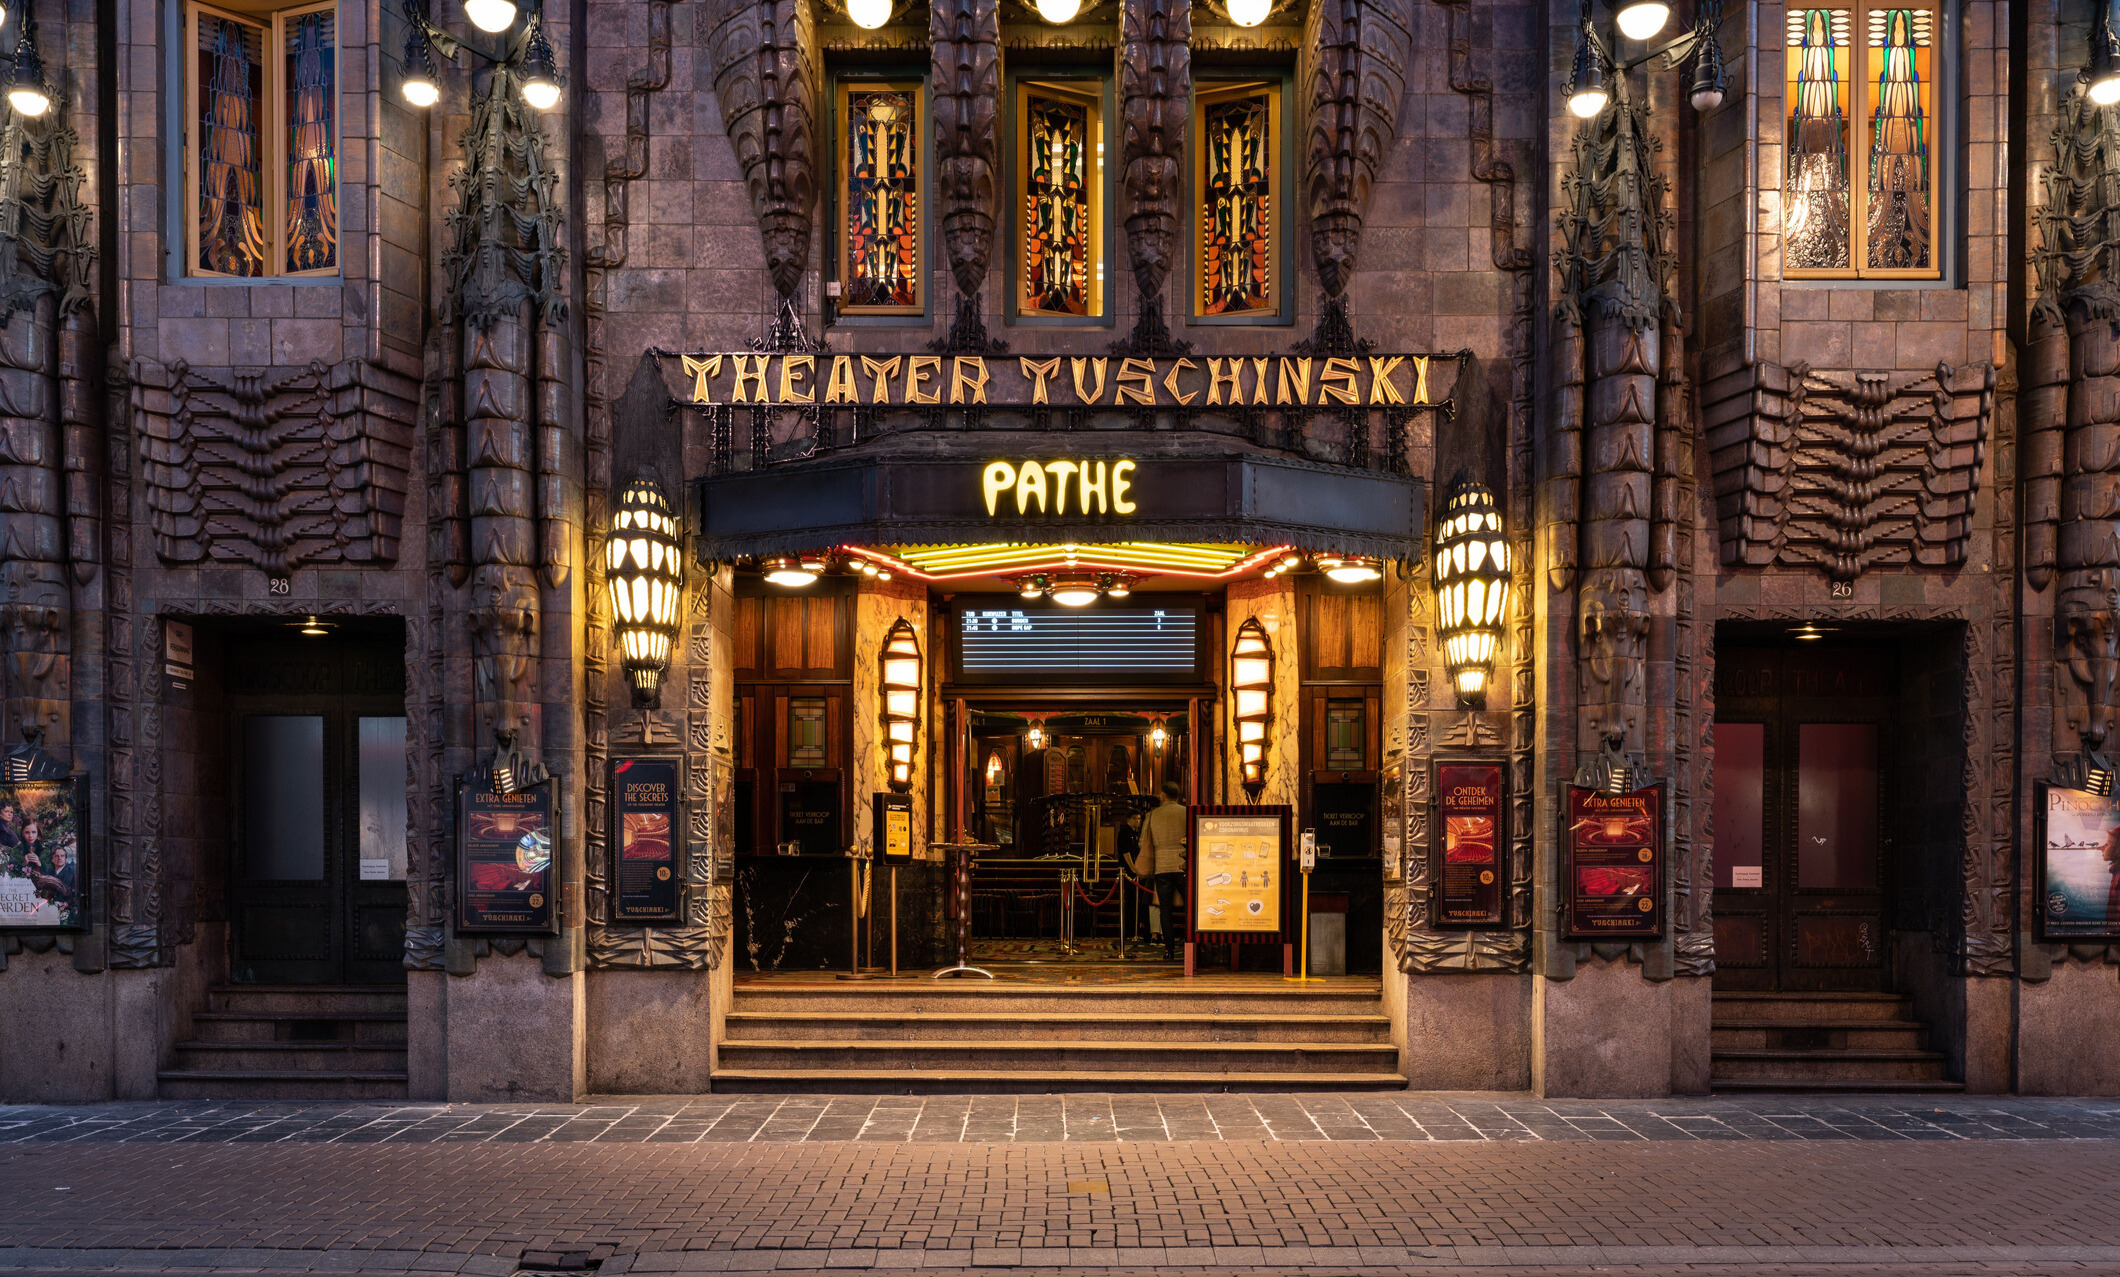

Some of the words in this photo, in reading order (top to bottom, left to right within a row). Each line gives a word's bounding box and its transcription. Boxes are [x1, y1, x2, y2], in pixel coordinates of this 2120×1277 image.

[681, 354, 990, 404] THEATER
[1020, 356, 1428, 406] TUSCHINSKI
[983, 460, 1137, 516] PATHE
[270, 578, 289, 594] 28
[1833, 582, 1852, 597] 26
[1085, 717, 1101, 725] ZAAL
[627, 783, 666, 793] DISCOVER
[1453, 786, 1486, 796] ONTDEK
[475, 793, 500, 803] EXTRA
[502, 793, 537, 803] GENIETEN
[624, 793, 637, 802] THE
[639, 793, 669, 802] SECRETS
[1445, 796, 1456, 805] DE
[1458, 796, 1494, 805] GEHEIMEN
[1583, 797, 1608, 807] EXTRA
[1610, 797, 1645, 807] GENIETEN
[2048, 793, 2120, 811] PINOCCH
[0, 893, 30, 902] ECRET
[0, 902, 39, 912] ARDEN
